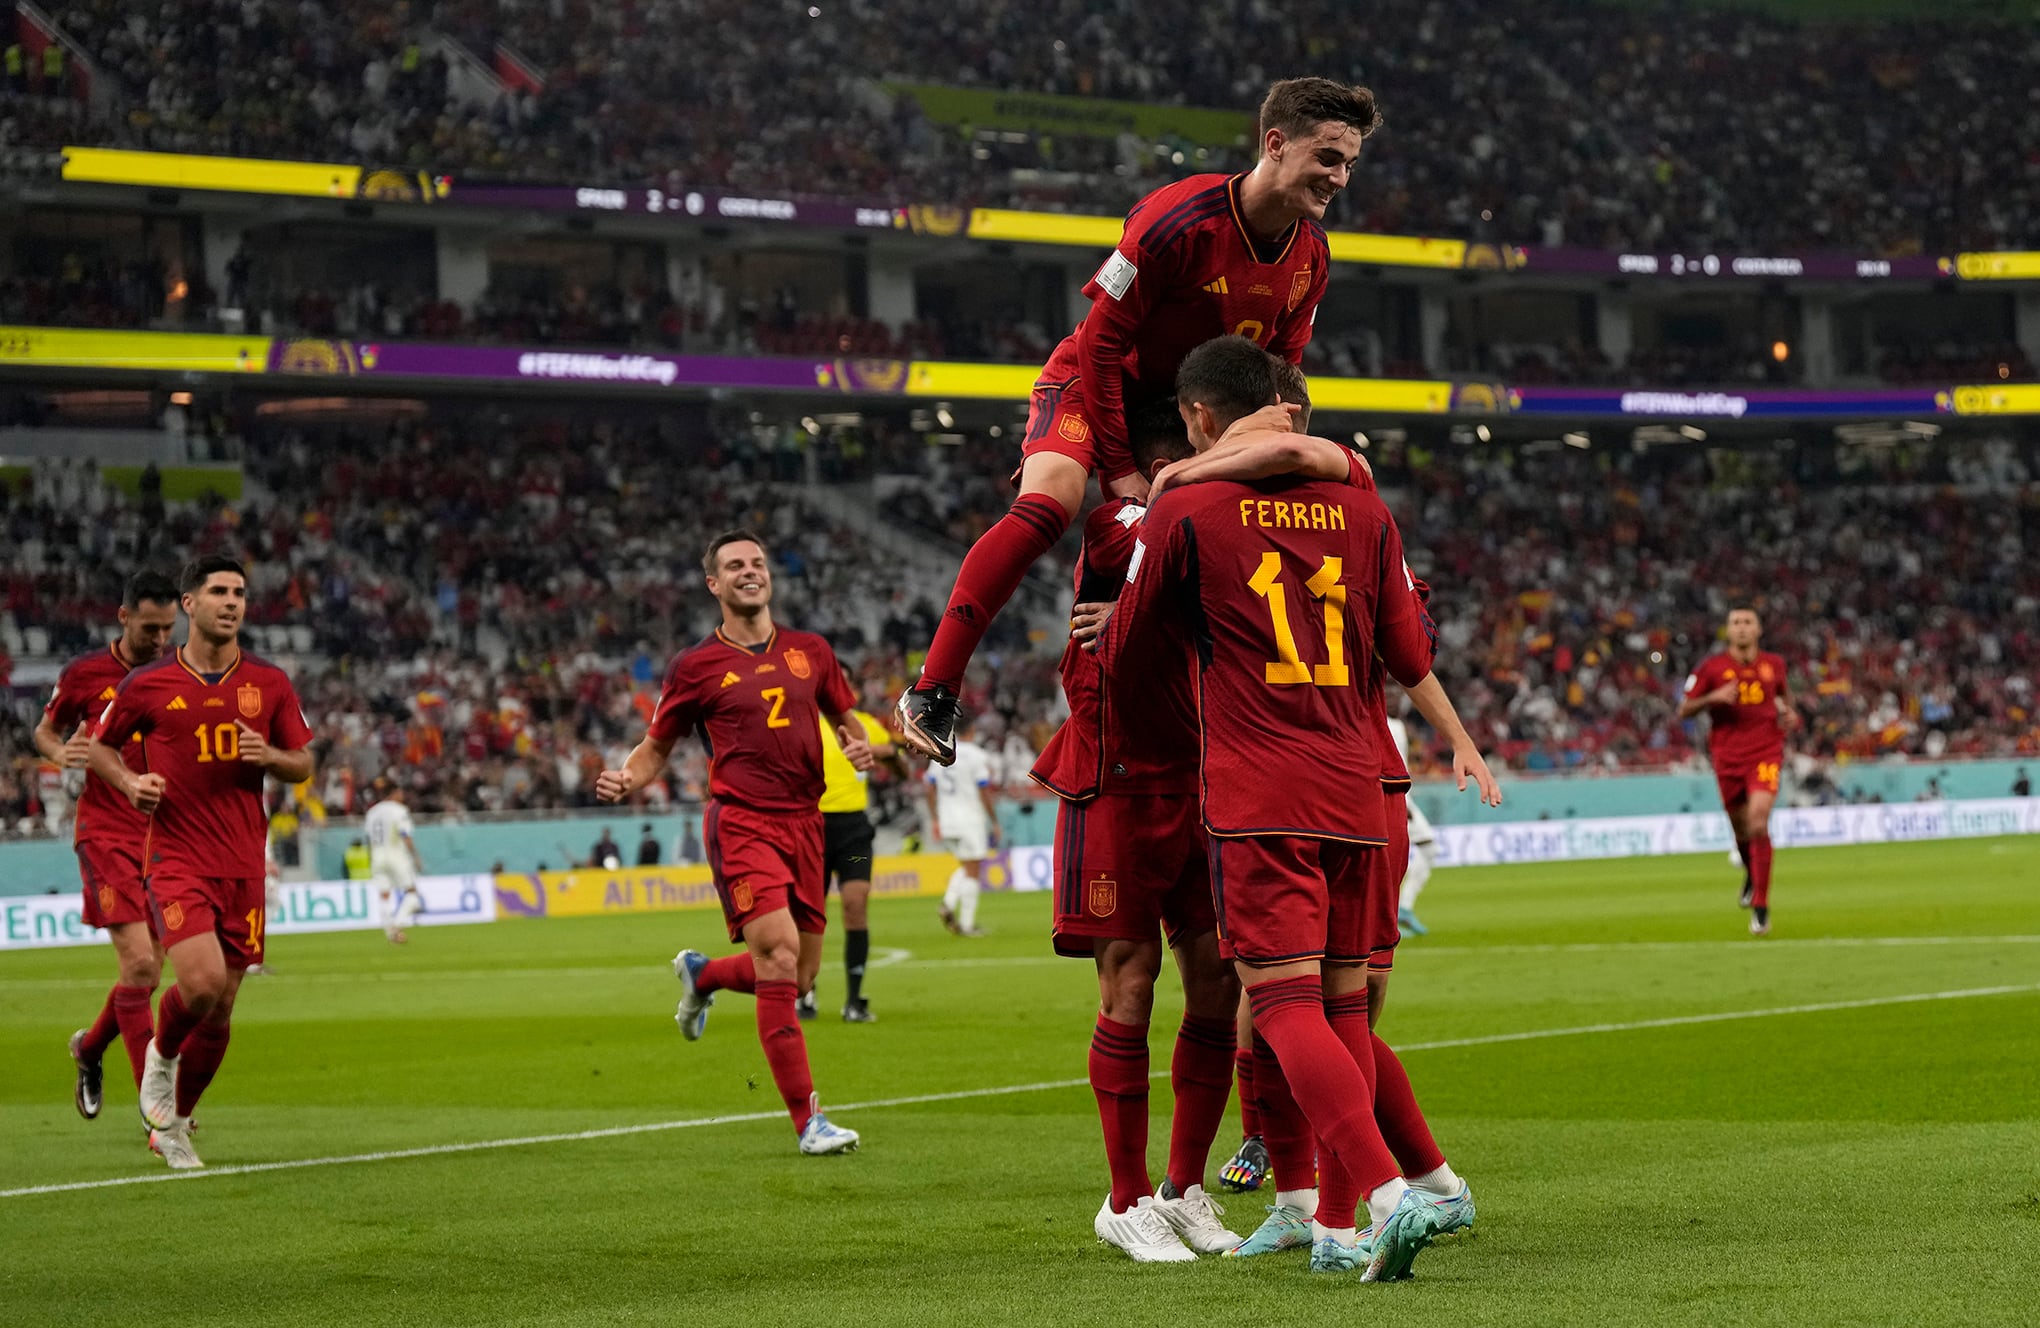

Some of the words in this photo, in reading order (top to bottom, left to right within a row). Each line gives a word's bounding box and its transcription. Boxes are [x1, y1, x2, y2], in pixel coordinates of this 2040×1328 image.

[1240, 500, 1345, 530] FERRAN
[1247, 552, 1349, 686] 11
[761, 687, 790, 728] 2
[1739, 681, 1764, 704] 16
[194, 723, 238, 762] 10
